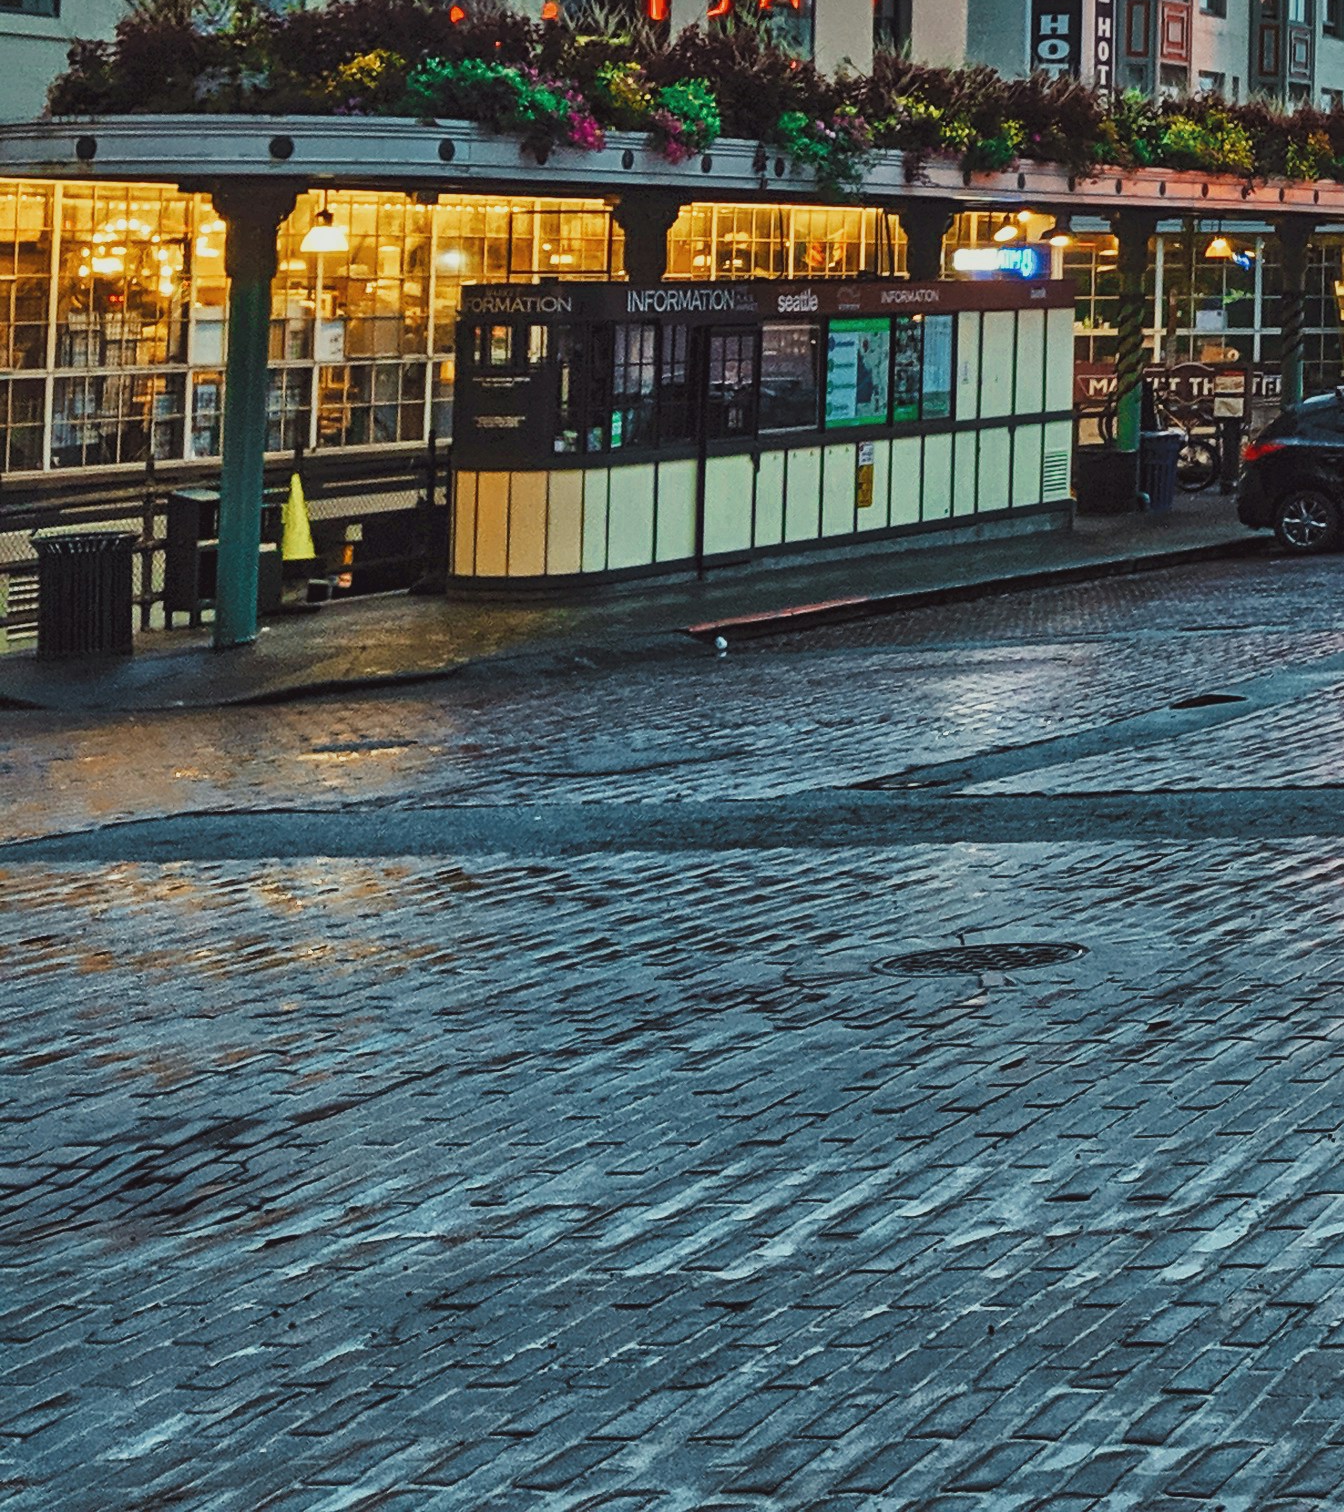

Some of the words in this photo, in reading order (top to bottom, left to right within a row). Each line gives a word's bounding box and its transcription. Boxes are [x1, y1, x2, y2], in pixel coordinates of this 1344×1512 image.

[627, 289, 735, 312] INFORMATION
[777, 288, 818, 313] seattle
[881, 289, 939, 304] INFORMATION
